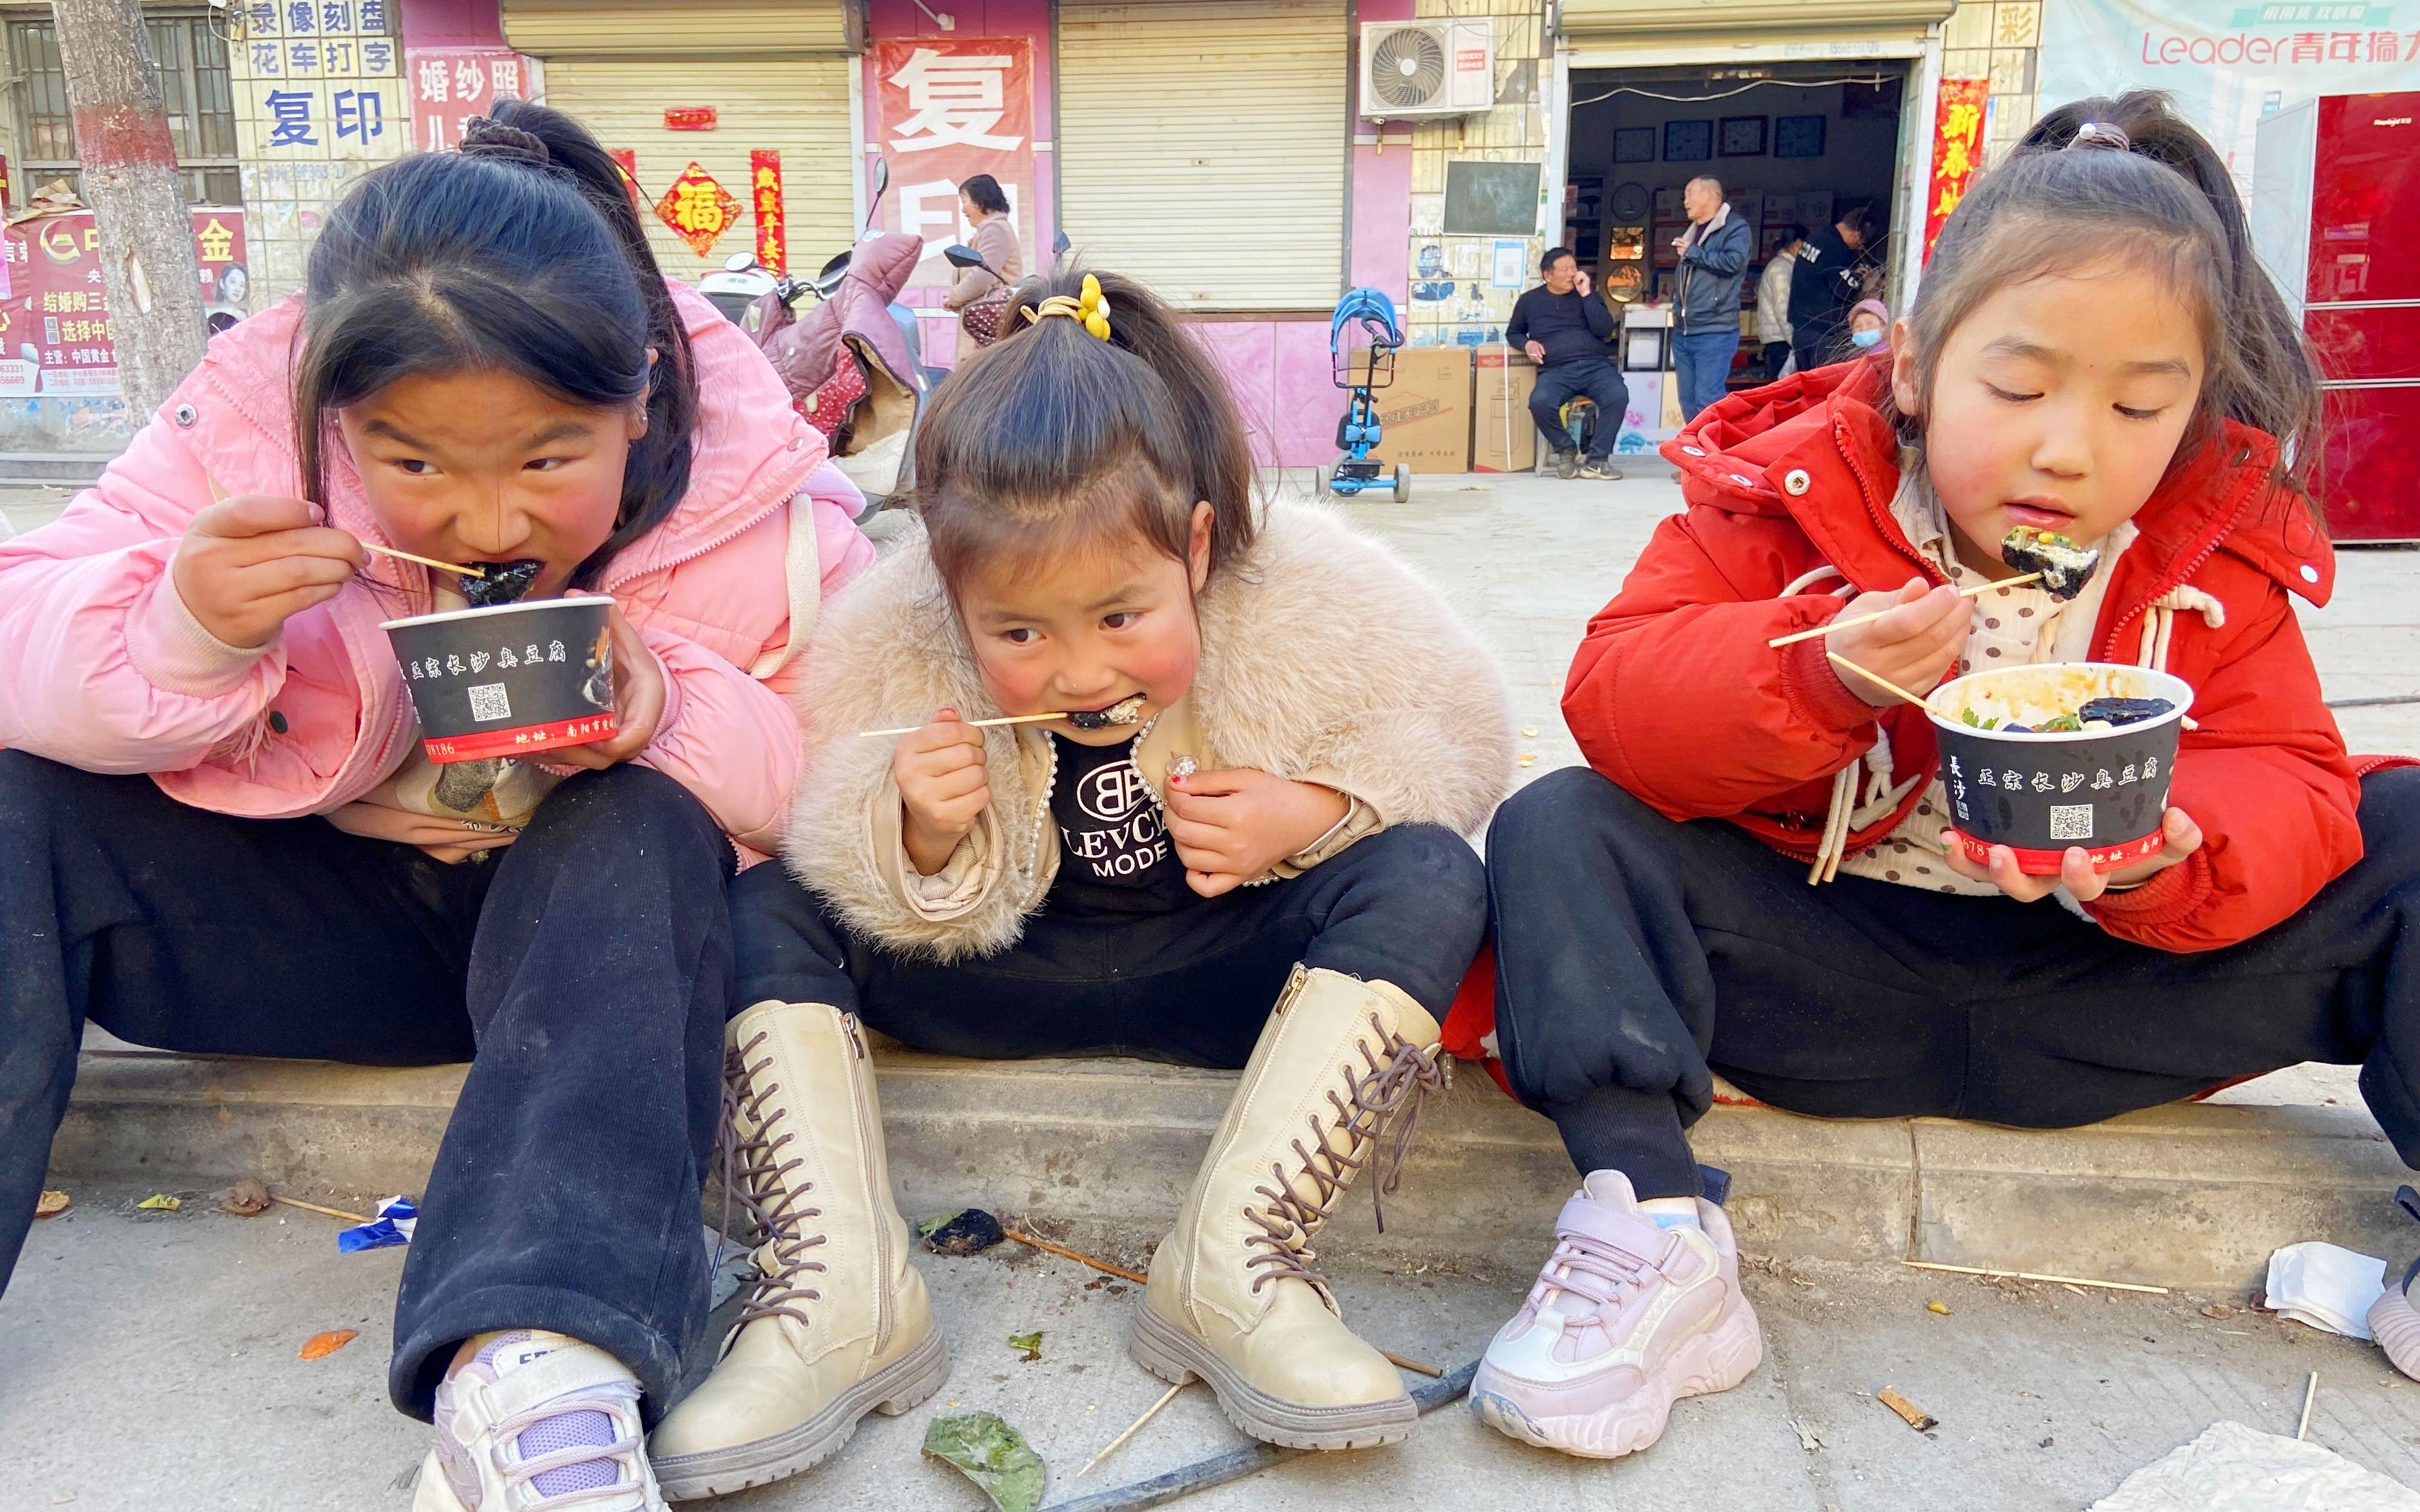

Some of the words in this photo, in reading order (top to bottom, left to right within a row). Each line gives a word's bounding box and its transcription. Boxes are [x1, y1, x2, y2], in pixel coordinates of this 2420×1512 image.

[250, 1, 385, 33] 录像刻盘
[1999, 6, 2032, 43] 彩
[251, 42, 391, 73] 花车打字
[2142, 32, 2288, 64] Leader
[419, 59, 521, 103] 婚纱照
[265, 89, 383, 146] 复印
[675, 181, 723, 232] 福
[198, 218, 234, 262] 金
[0, 376, 25, 385] 56669
[412, 640, 567, 680] 正宗长沙臭豆腐
[1978, 757, 2158, 793] 正宗长沙臭豆腐
